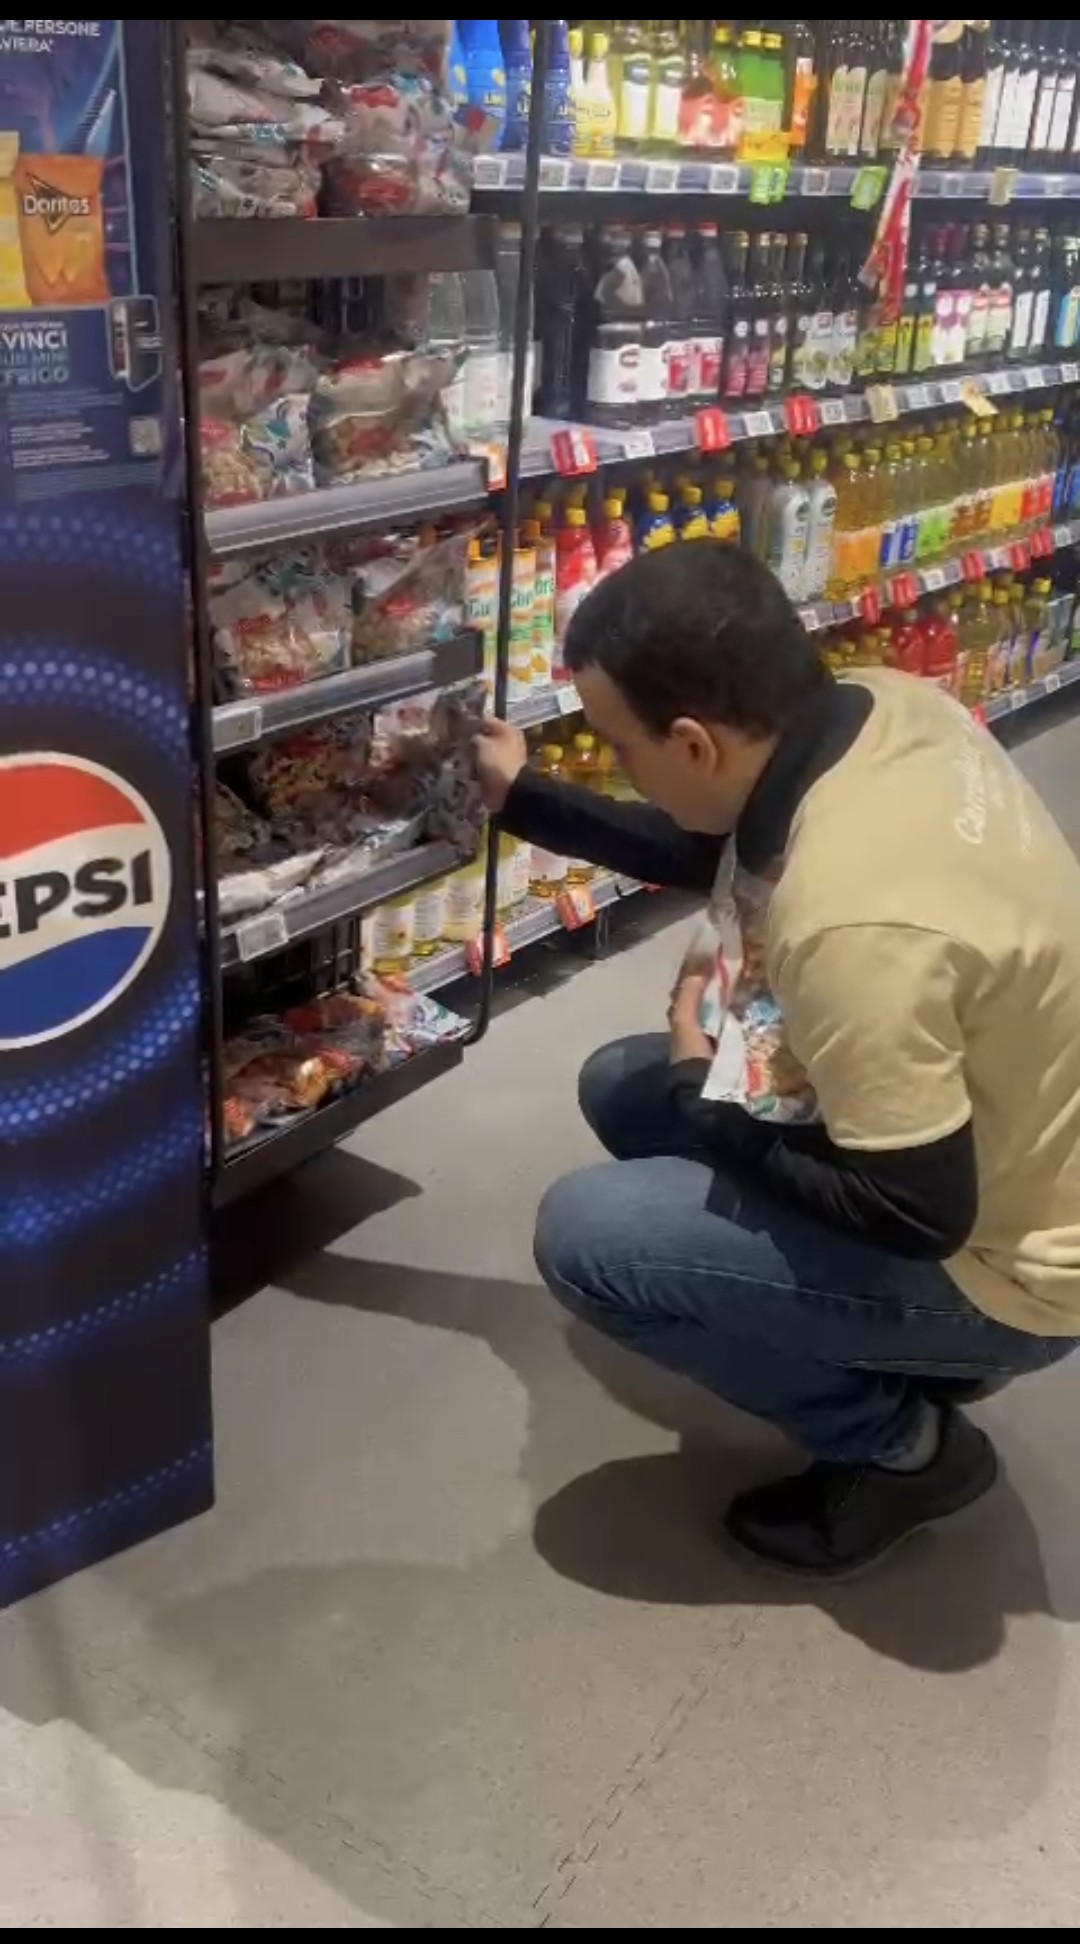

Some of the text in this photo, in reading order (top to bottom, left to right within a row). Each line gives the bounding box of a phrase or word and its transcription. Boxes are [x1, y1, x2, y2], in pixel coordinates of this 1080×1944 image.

[24, 20, 100, 36] PERSONE
[24, 195, 90, 214] Doritos
[2, 330, 68, 351] VINCI
[0, 849, 153, 939] PSI
